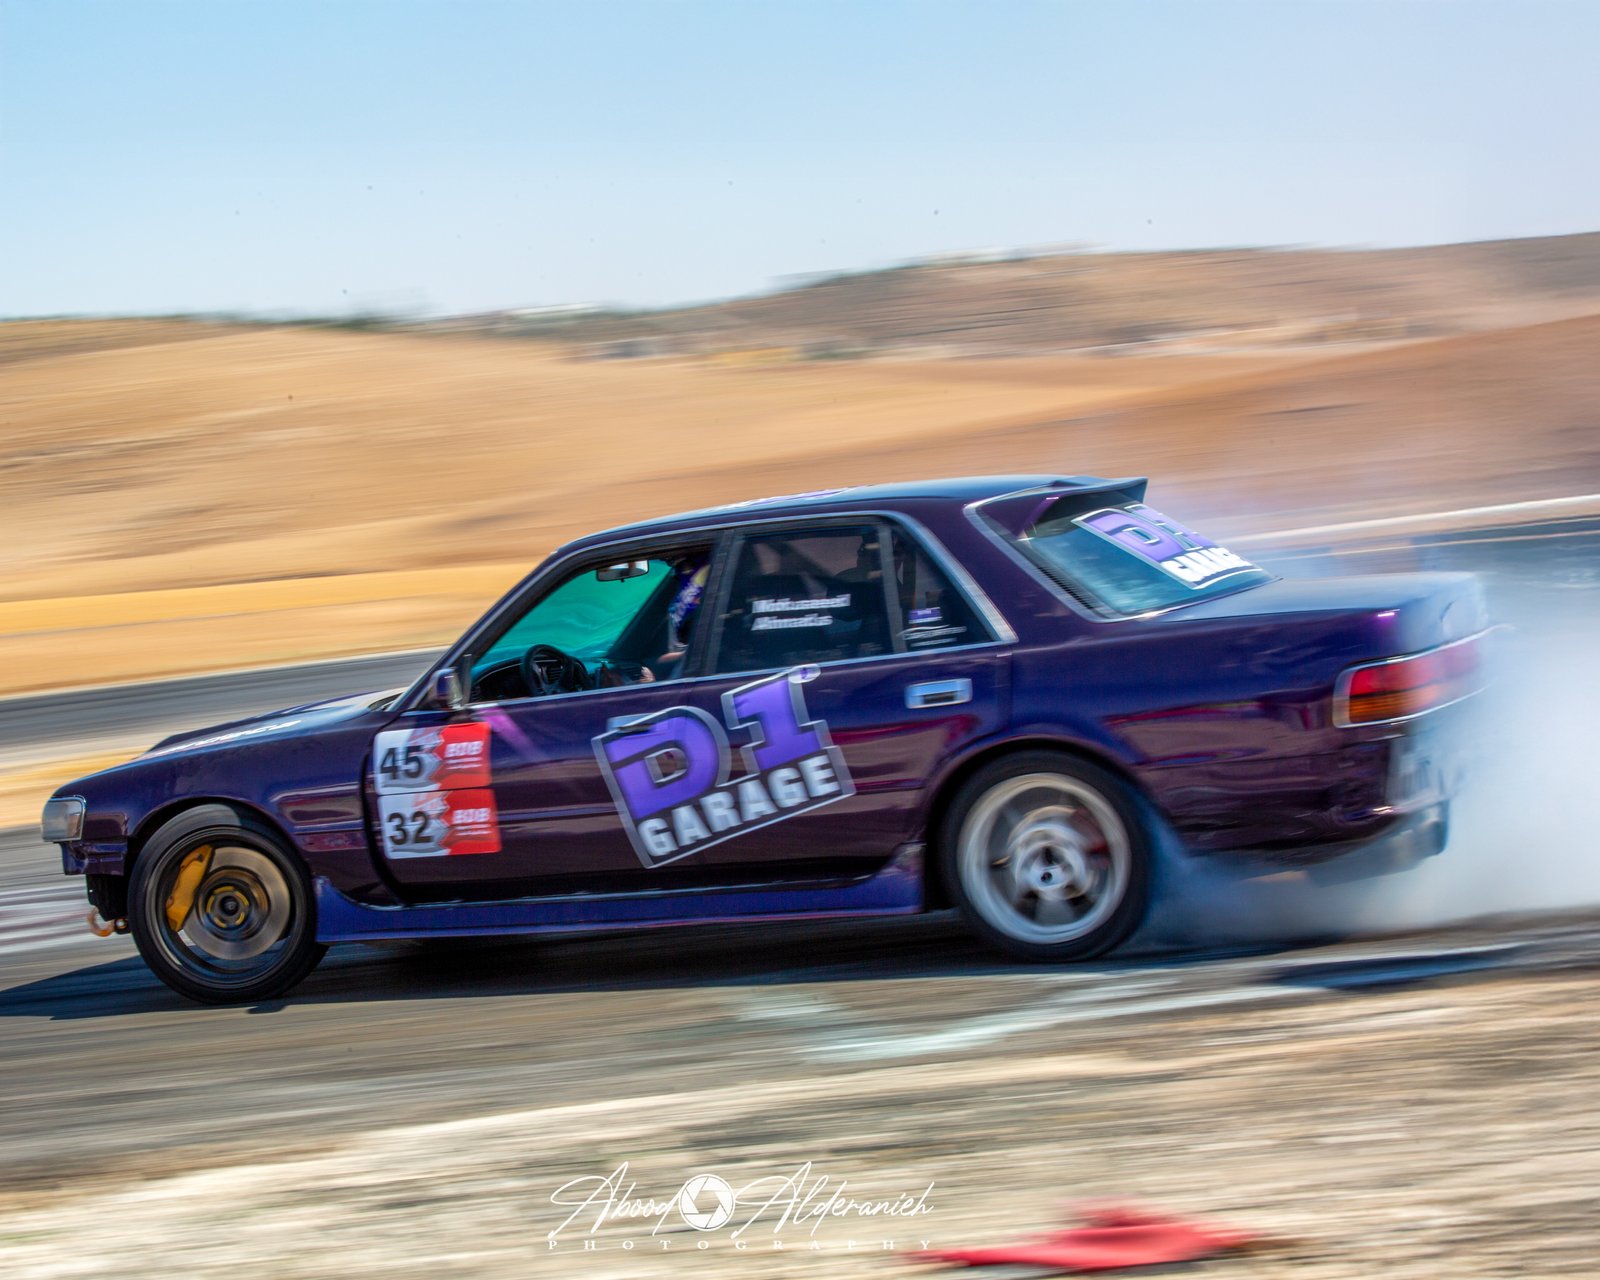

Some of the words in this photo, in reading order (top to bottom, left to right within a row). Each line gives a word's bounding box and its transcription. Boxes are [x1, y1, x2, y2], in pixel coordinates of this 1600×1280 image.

[380, 745, 423, 780] 45
[601, 676, 825, 820] D1
[386, 811, 434, 846] 32
[637, 754, 842, 857] GARAGE
